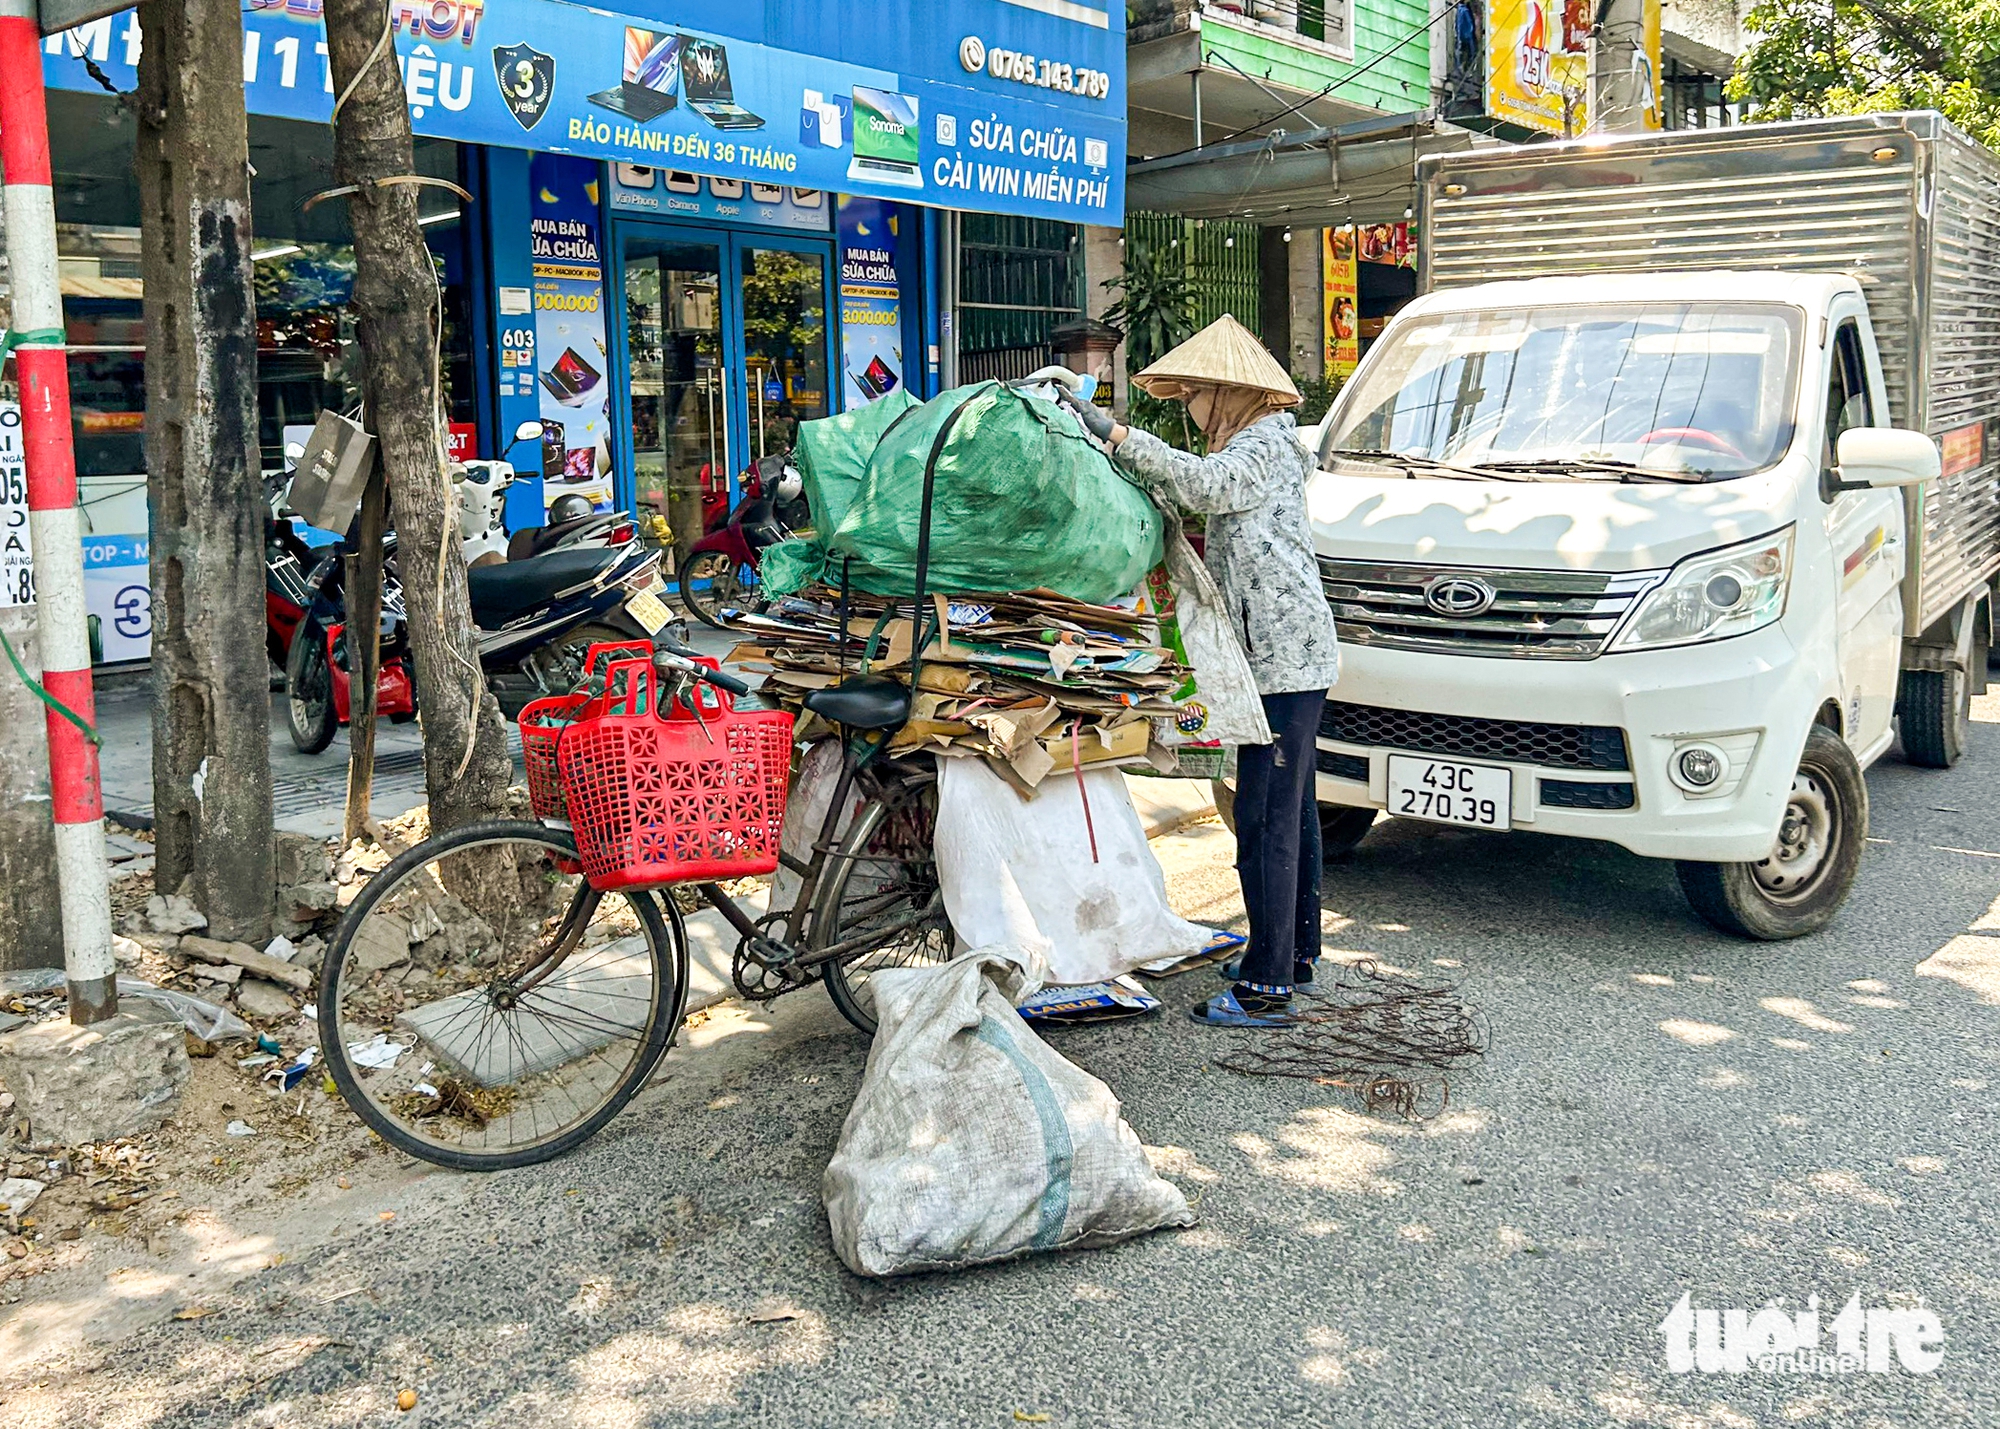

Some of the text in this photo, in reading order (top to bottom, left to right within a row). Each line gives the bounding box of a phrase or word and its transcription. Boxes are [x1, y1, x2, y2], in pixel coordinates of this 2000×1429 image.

[514, 59, 535, 99] 3
[987, 47, 1110, 100] 0765.143.789
[513, 101, 540, 115] year
[869, 115, 905, 136] Sonoma
[568, 114, 797, 172] BẢO HÀNH ĐẾN 36 THÁNG
[969, 112, 1078, 164] SỬA CHỮA
[933, 151, 1110, 209] CÀI WIN MIỄN PHÍ
[667, 198, 699, 213] Gaming
[716, 203, 740, 217] Apple
[761, 208, 774, 219] PC
[558, 218, 587, 237] BÁN
[553, 239, 598, 260] CHỮA
[847, 247, 889, 263] MUA BÁN
[842, 261, 897, 281] SỬA CHỮA
[842, 309, 897, 327] 3.000.000
[502, 328, 535, 348] 603
[1422, 763, 1474, 793] 43C
[1400, 788, 1496, 825] 270.39
[1026, 998, 1102, 1016] LARUE
